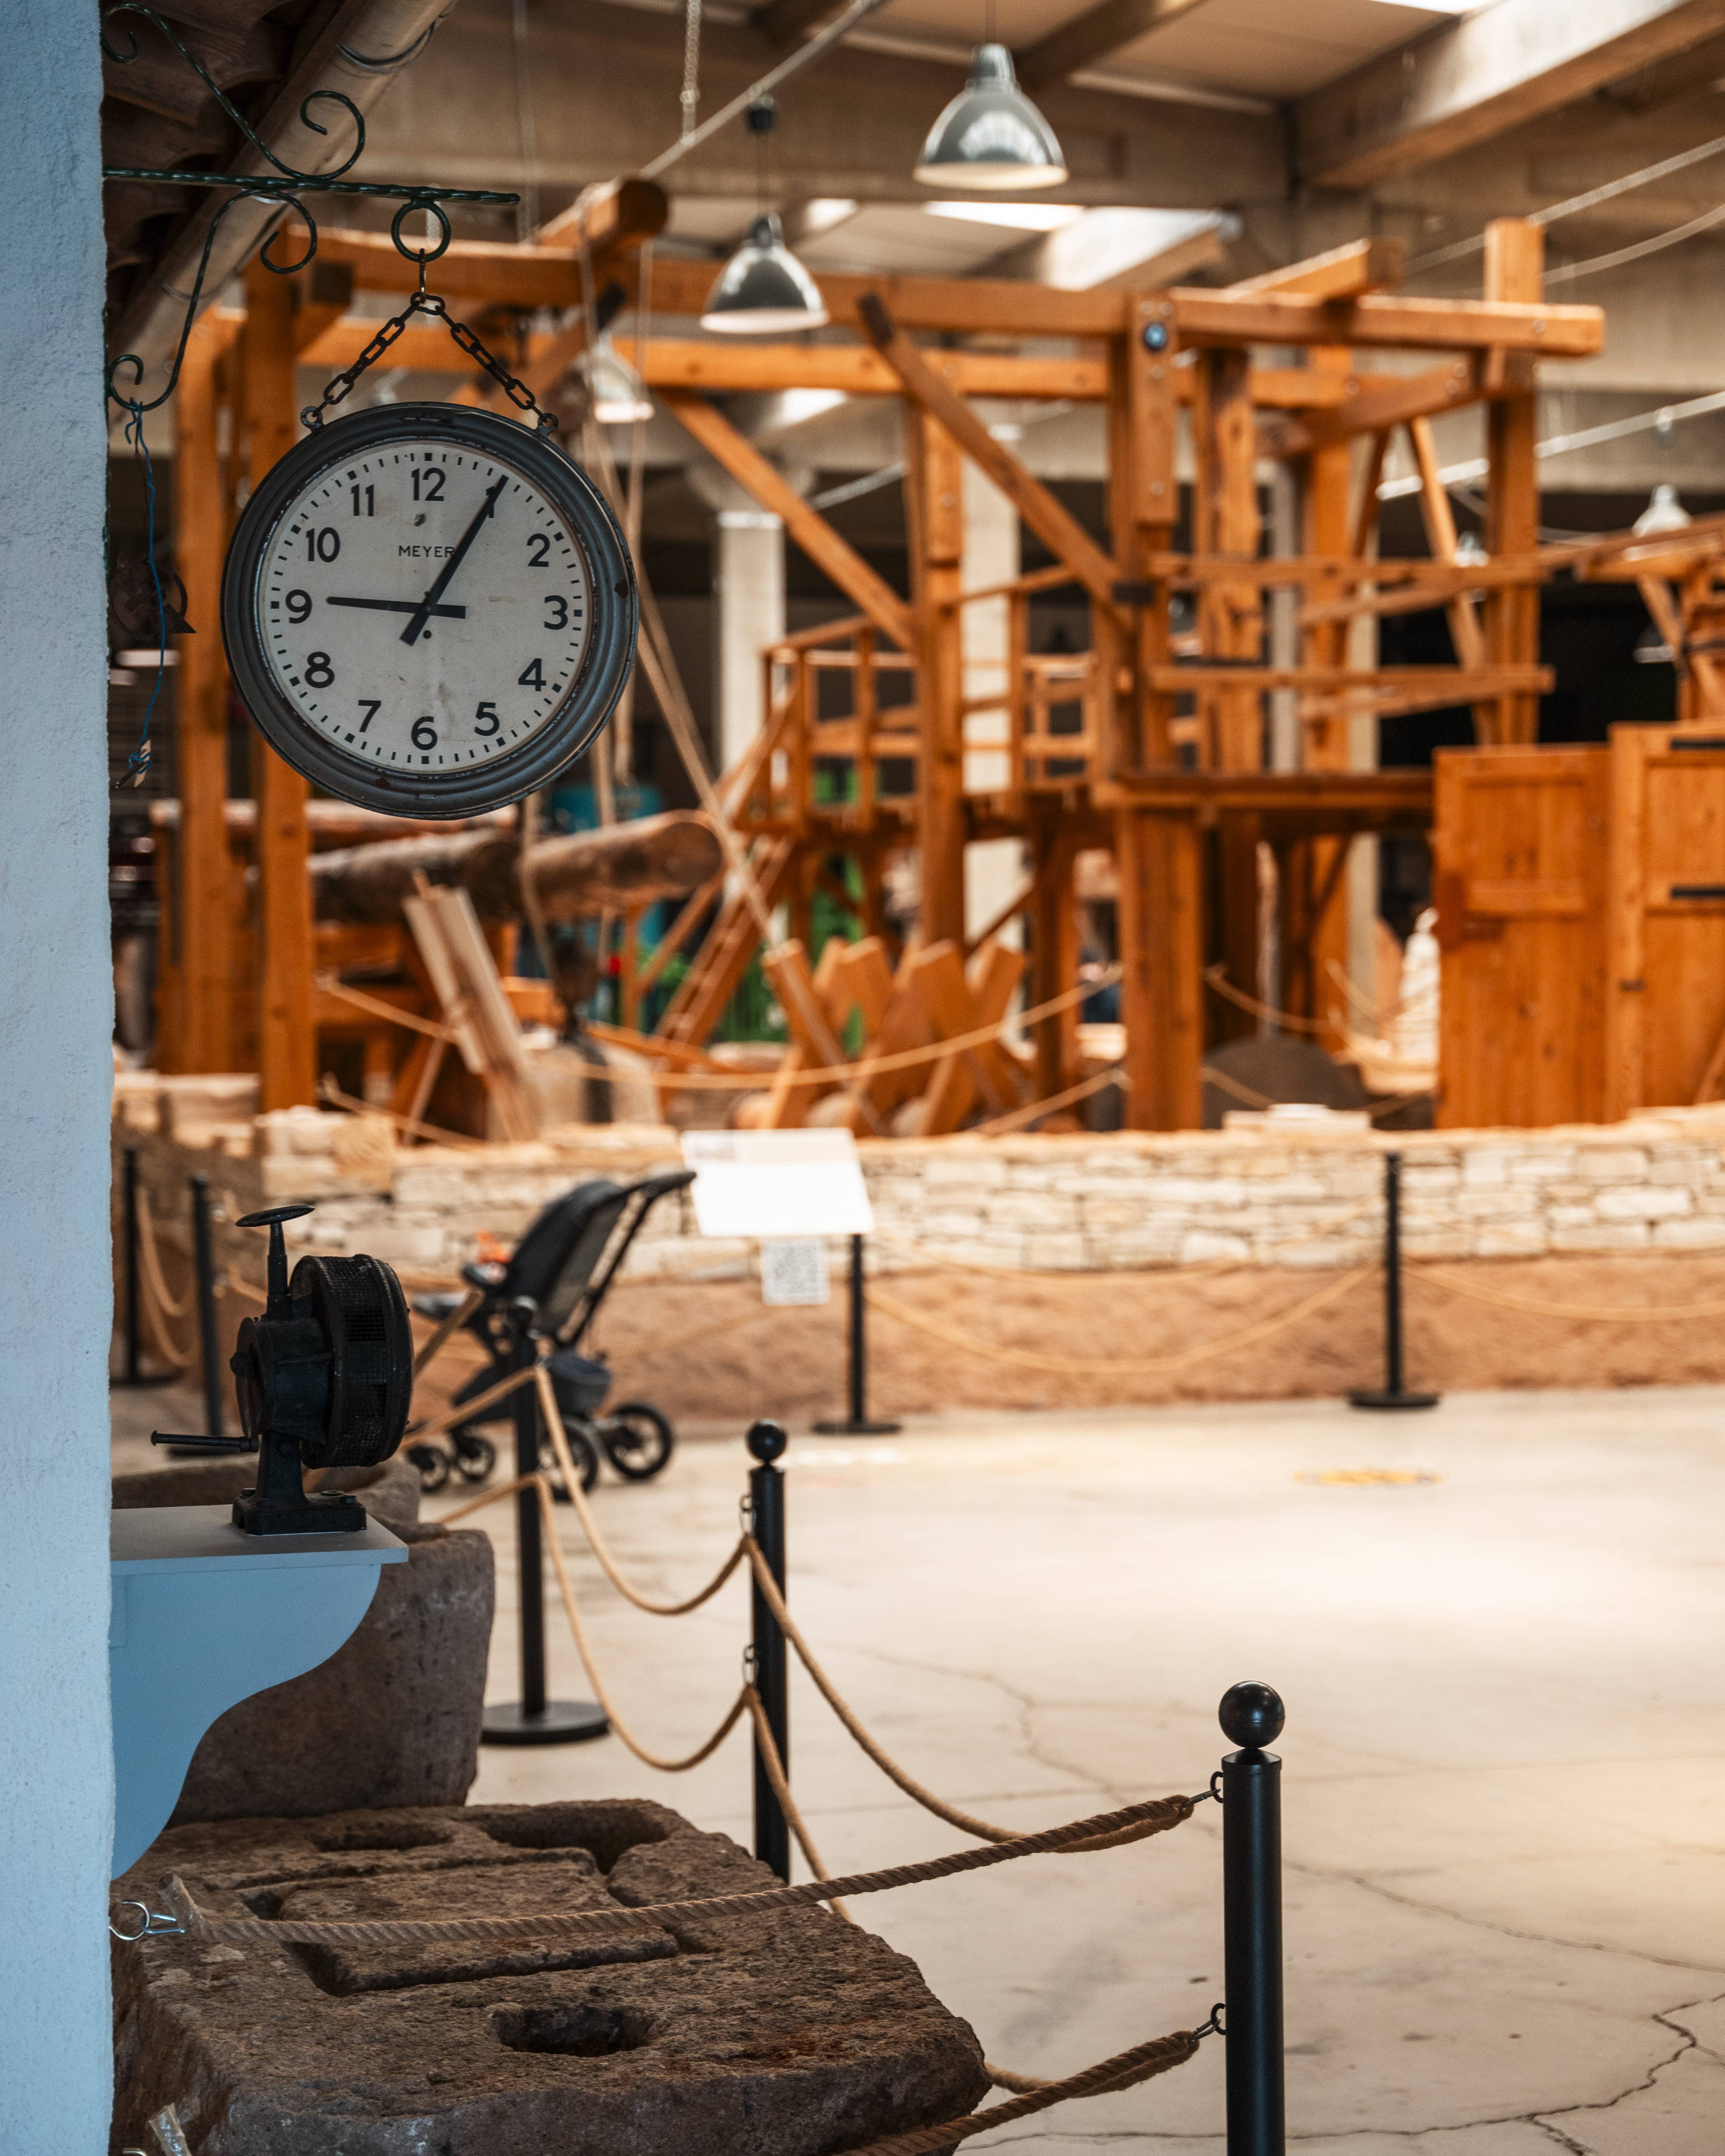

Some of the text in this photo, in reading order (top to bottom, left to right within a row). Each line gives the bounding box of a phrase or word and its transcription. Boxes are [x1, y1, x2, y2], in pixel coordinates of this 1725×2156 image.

[350, 483, 375, 517] 11
[411, 467, 446, 502] 12
[305, 527, 341, 563] 10
[399, 545, 455, 558] MEYER
[526, 533, 551, 568] 2
[285, 589, 313, 624] 9
[544, 595, 568, 630] 3
[304, 651, 335, 689] 8
[518, 658, 547, 692] 4
[358, 699, 381, 733] 7
[411, 716, 438, 751] 6
[474, 701, 500, 736] 5
